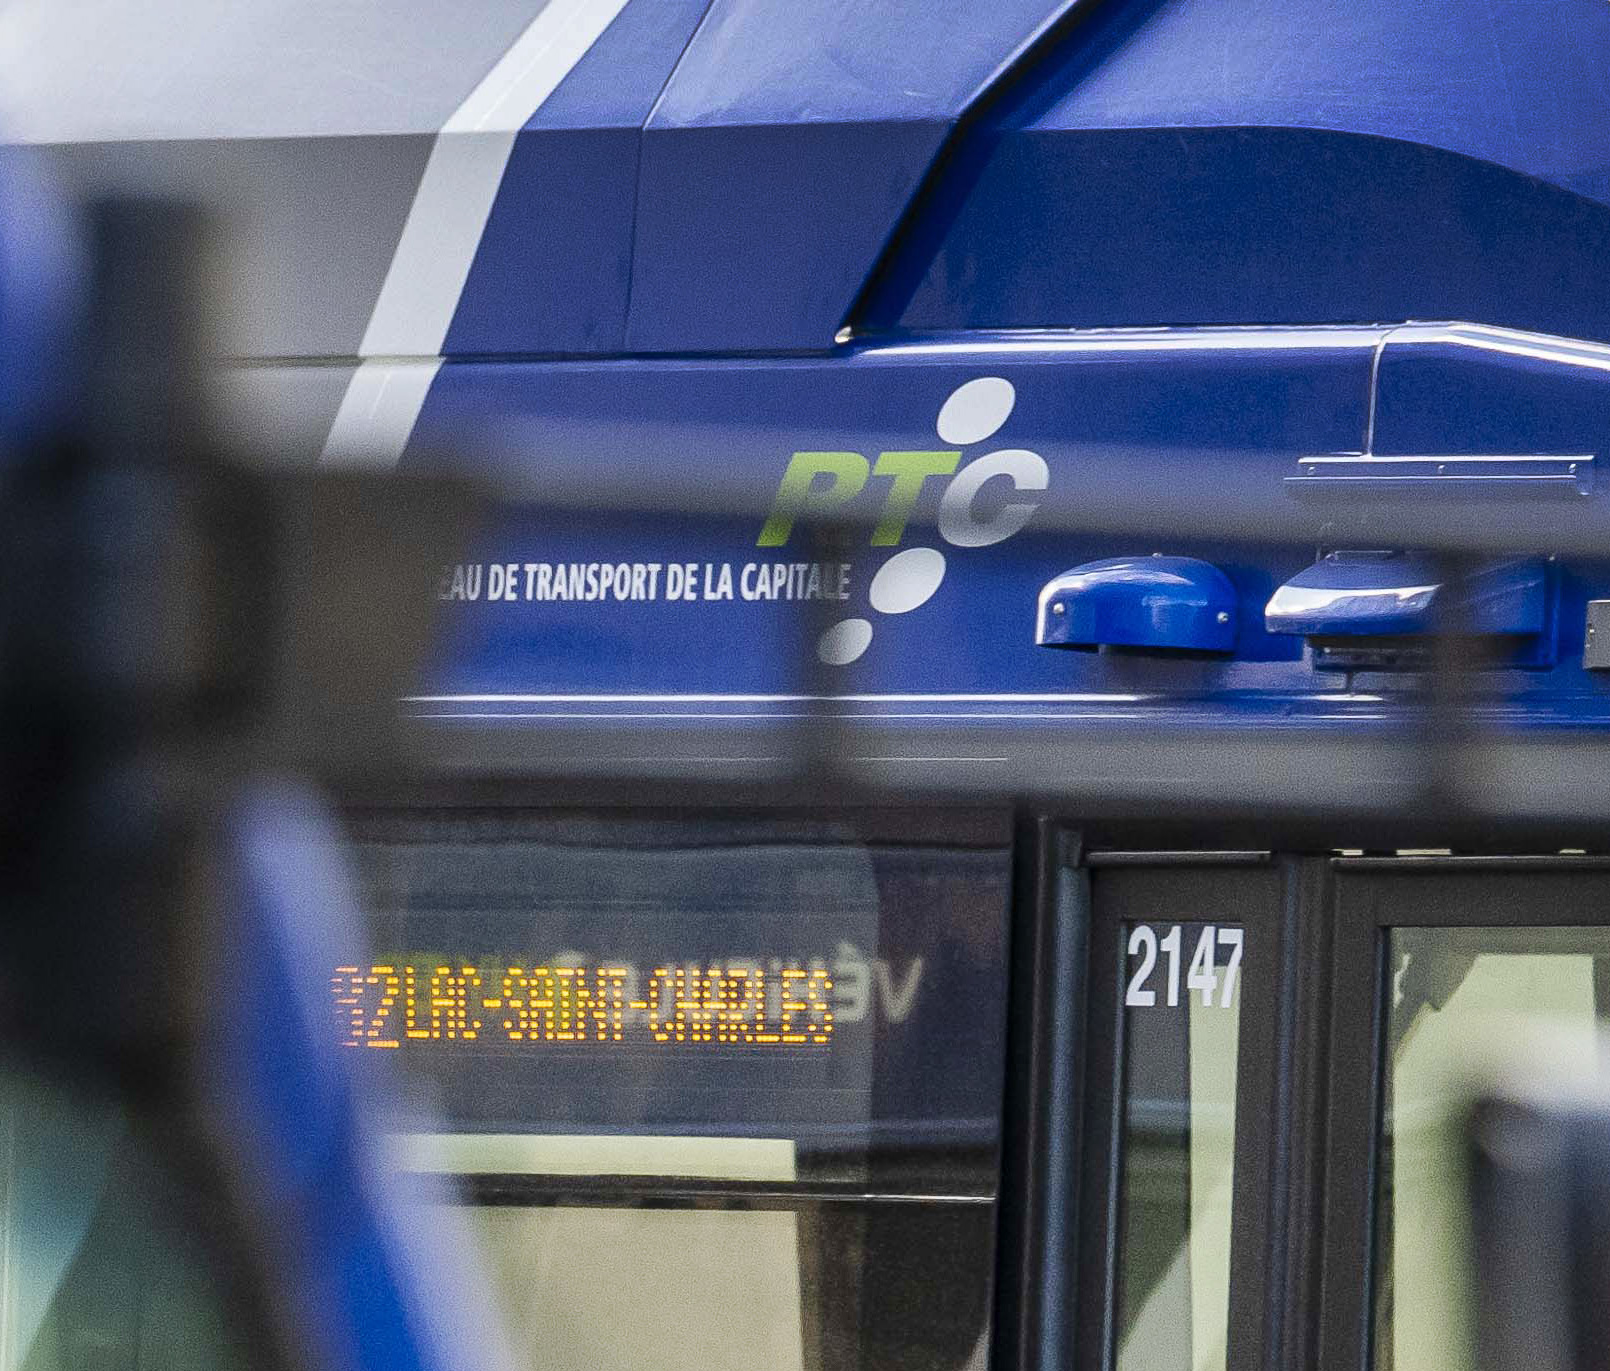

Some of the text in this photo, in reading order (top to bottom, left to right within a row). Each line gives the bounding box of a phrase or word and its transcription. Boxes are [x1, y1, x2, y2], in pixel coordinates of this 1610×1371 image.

[487, 563, 517, 600] DE
[524, 563, 662, 600] TRANSPORT
[666, 563, 698, 600] DE
[704, 563, 733, 600] LA
[405, 965, 834, 1044] LAC-SAINT-CHARLES
[1125, 924, 1245, 1008] 2147
